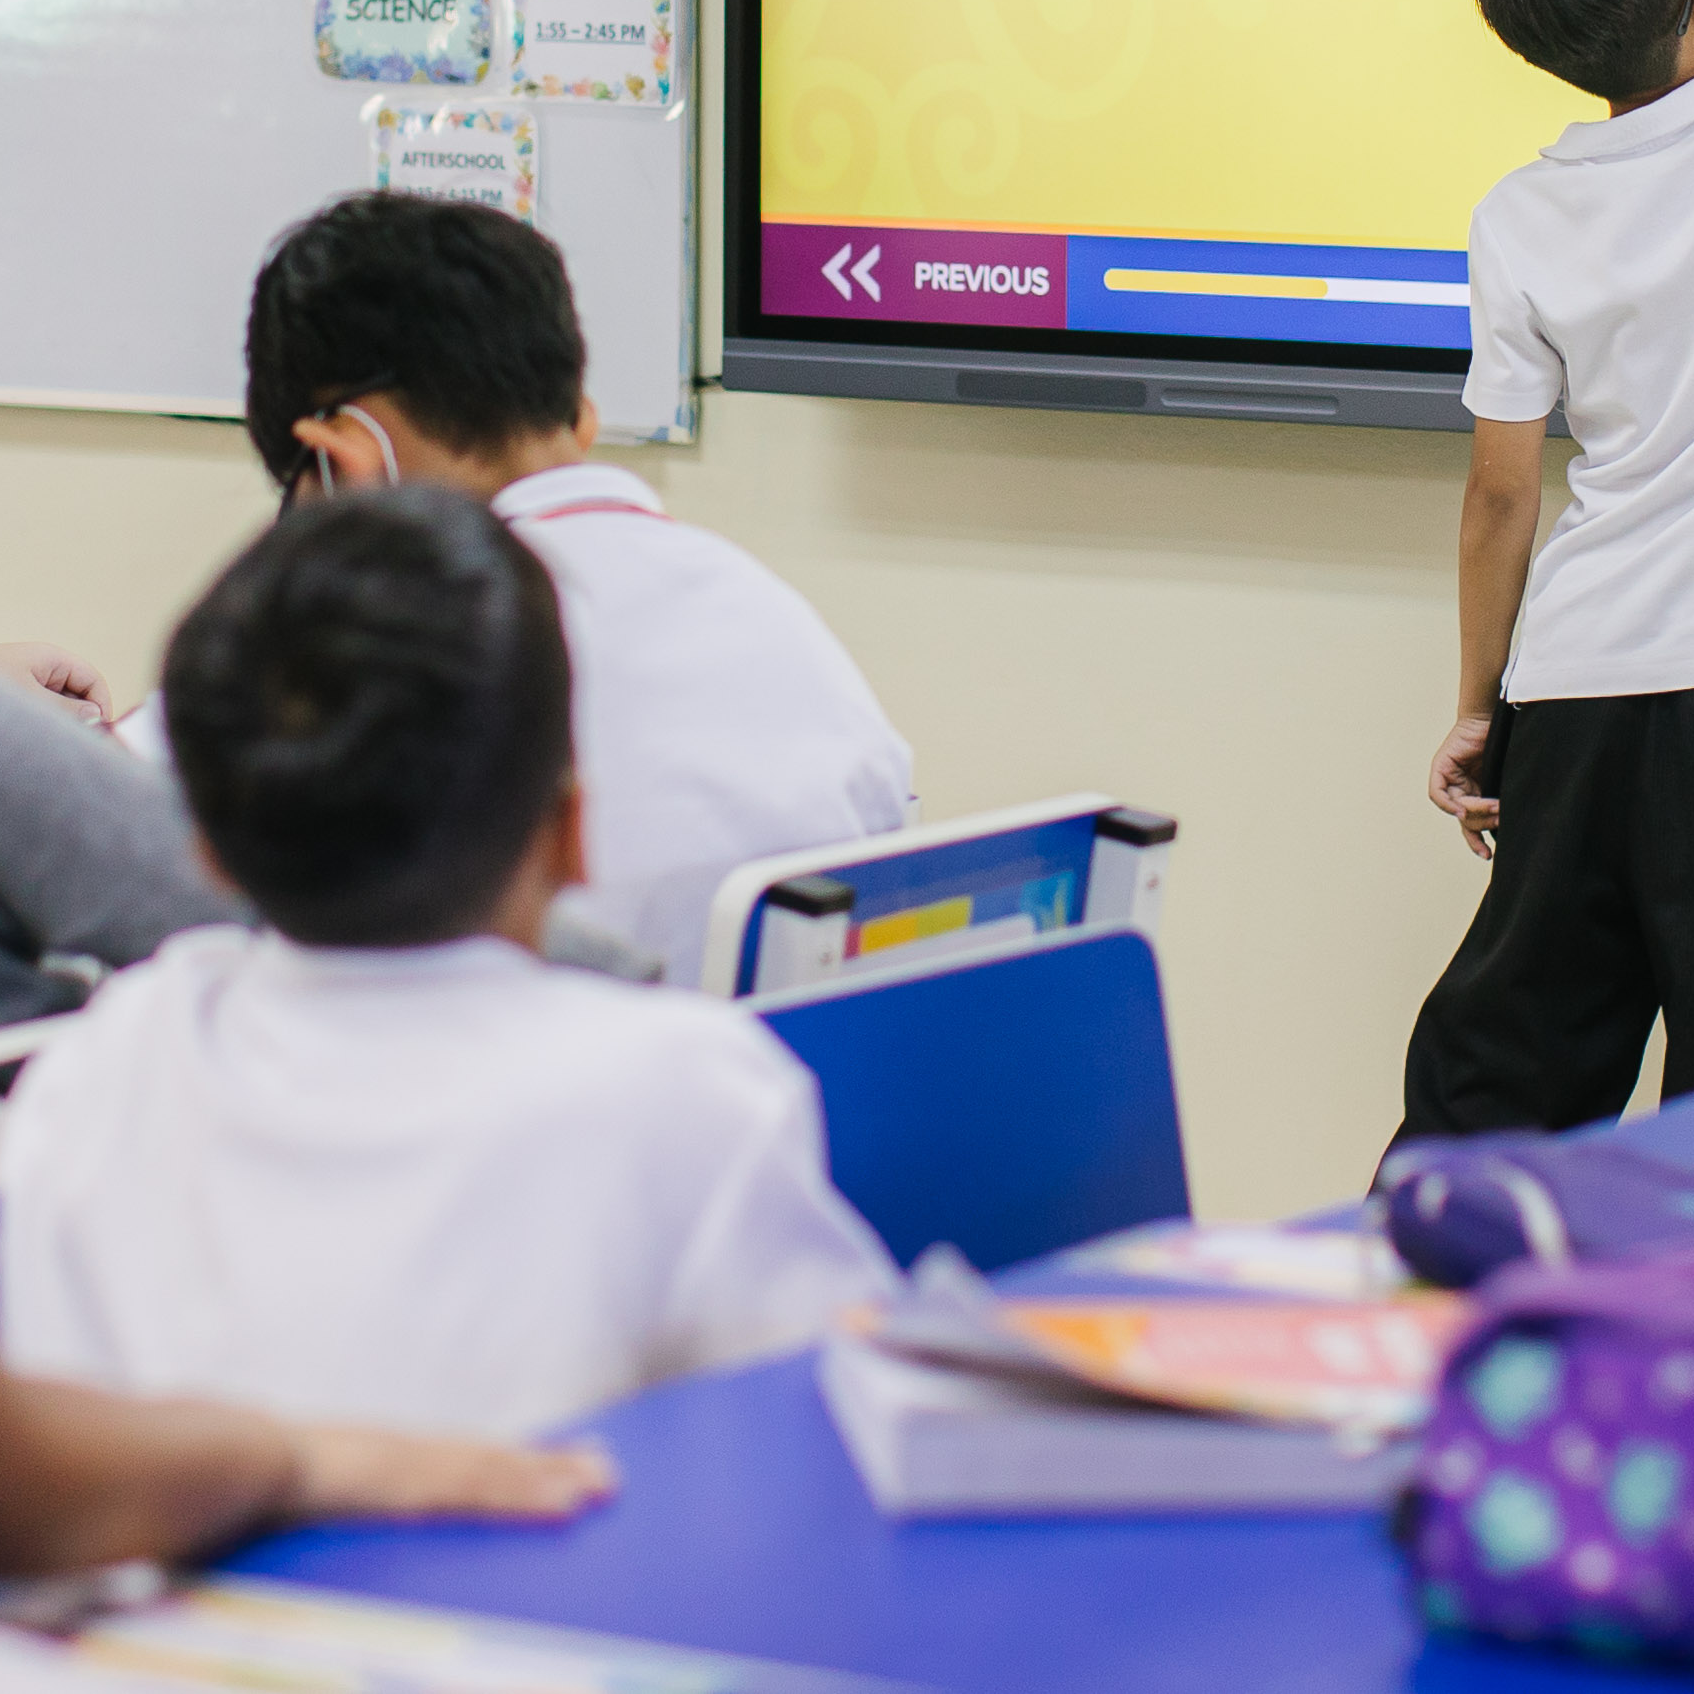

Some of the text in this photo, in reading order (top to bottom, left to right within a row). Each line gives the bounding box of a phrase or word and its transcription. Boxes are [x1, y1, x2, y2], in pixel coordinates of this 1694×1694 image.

[536, 23, 645, 39] 1:55 2:45 PM
[402, 152, 505, 169] AFTERSCHOOL
[915, 261, 1049, 296] PREVIOUS
